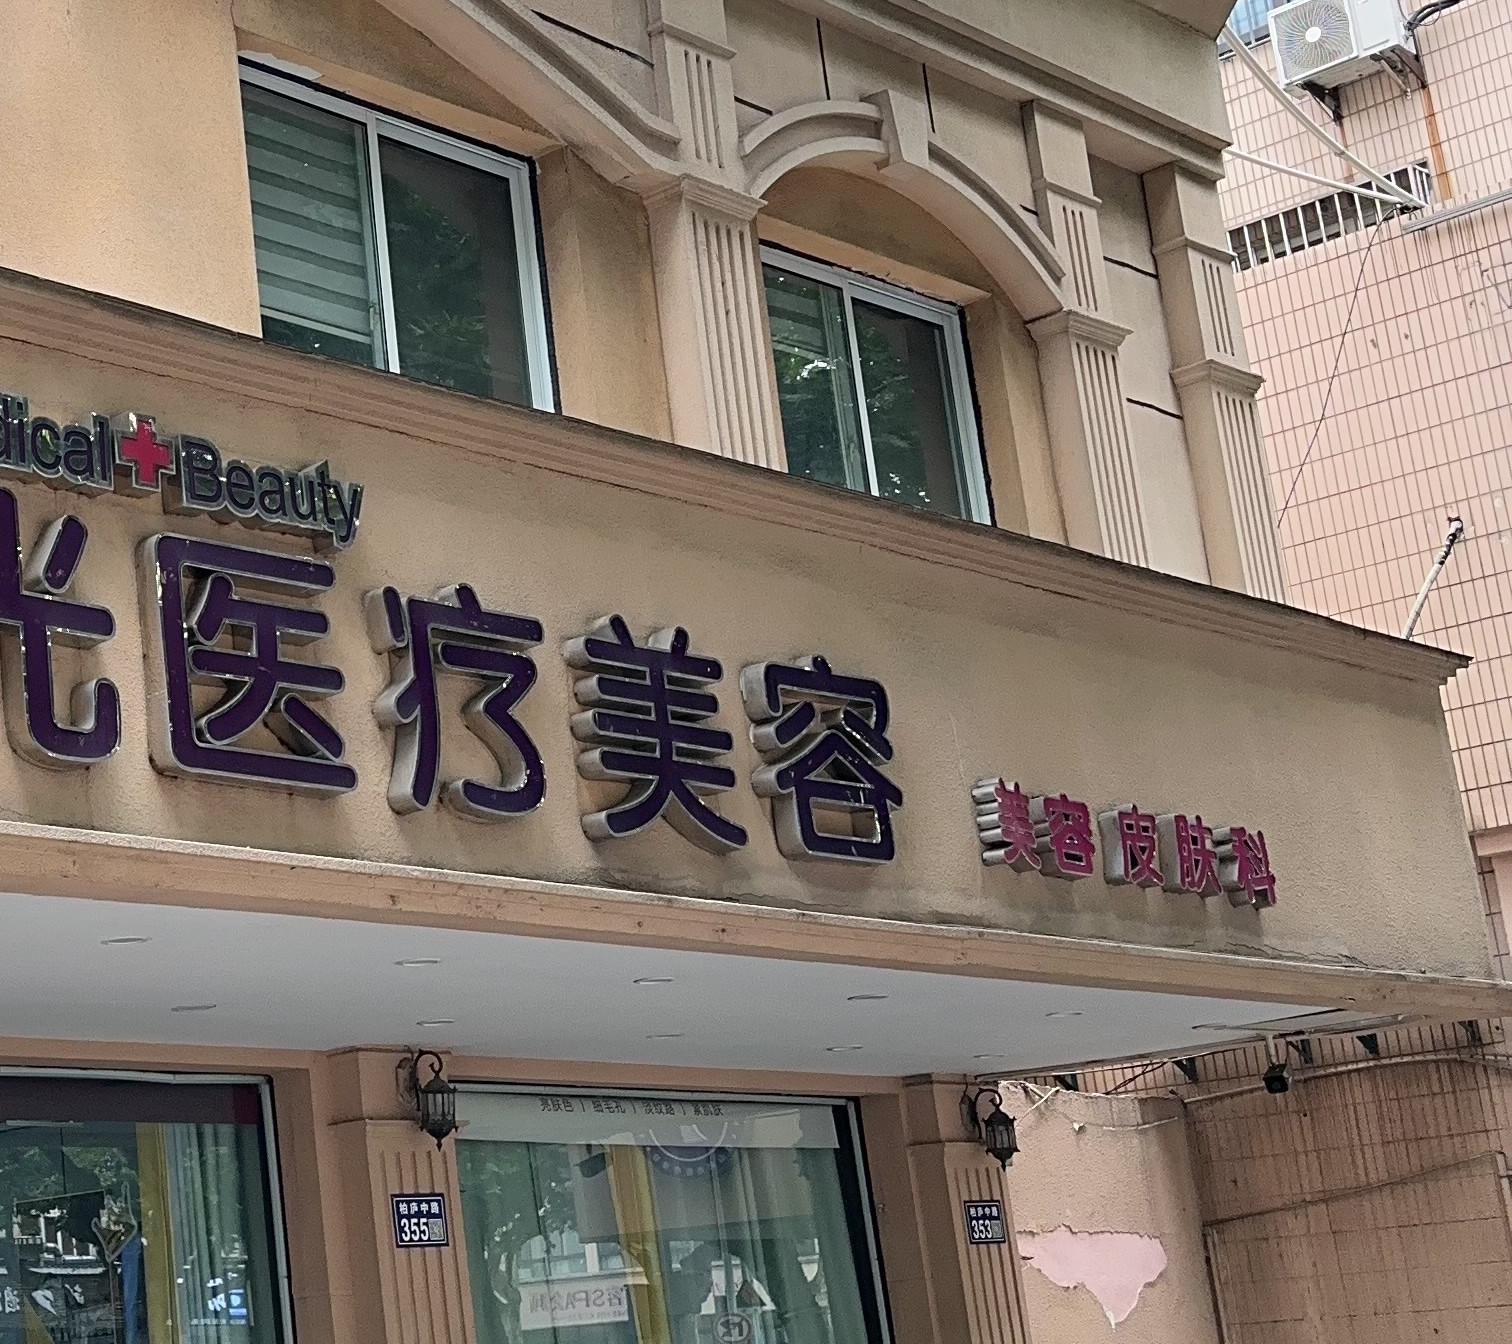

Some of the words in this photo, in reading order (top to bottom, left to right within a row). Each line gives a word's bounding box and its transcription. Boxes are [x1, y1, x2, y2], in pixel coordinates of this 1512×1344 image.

[164, 433, 366, 552] Beauty
[972, 778, 1278, 908] 美容皮肤科
[399, 1201, 439, 1215] 柏庐中路
[400, 1218, 429, 1242] 355
[971, 1219, 993, 1239] 353
